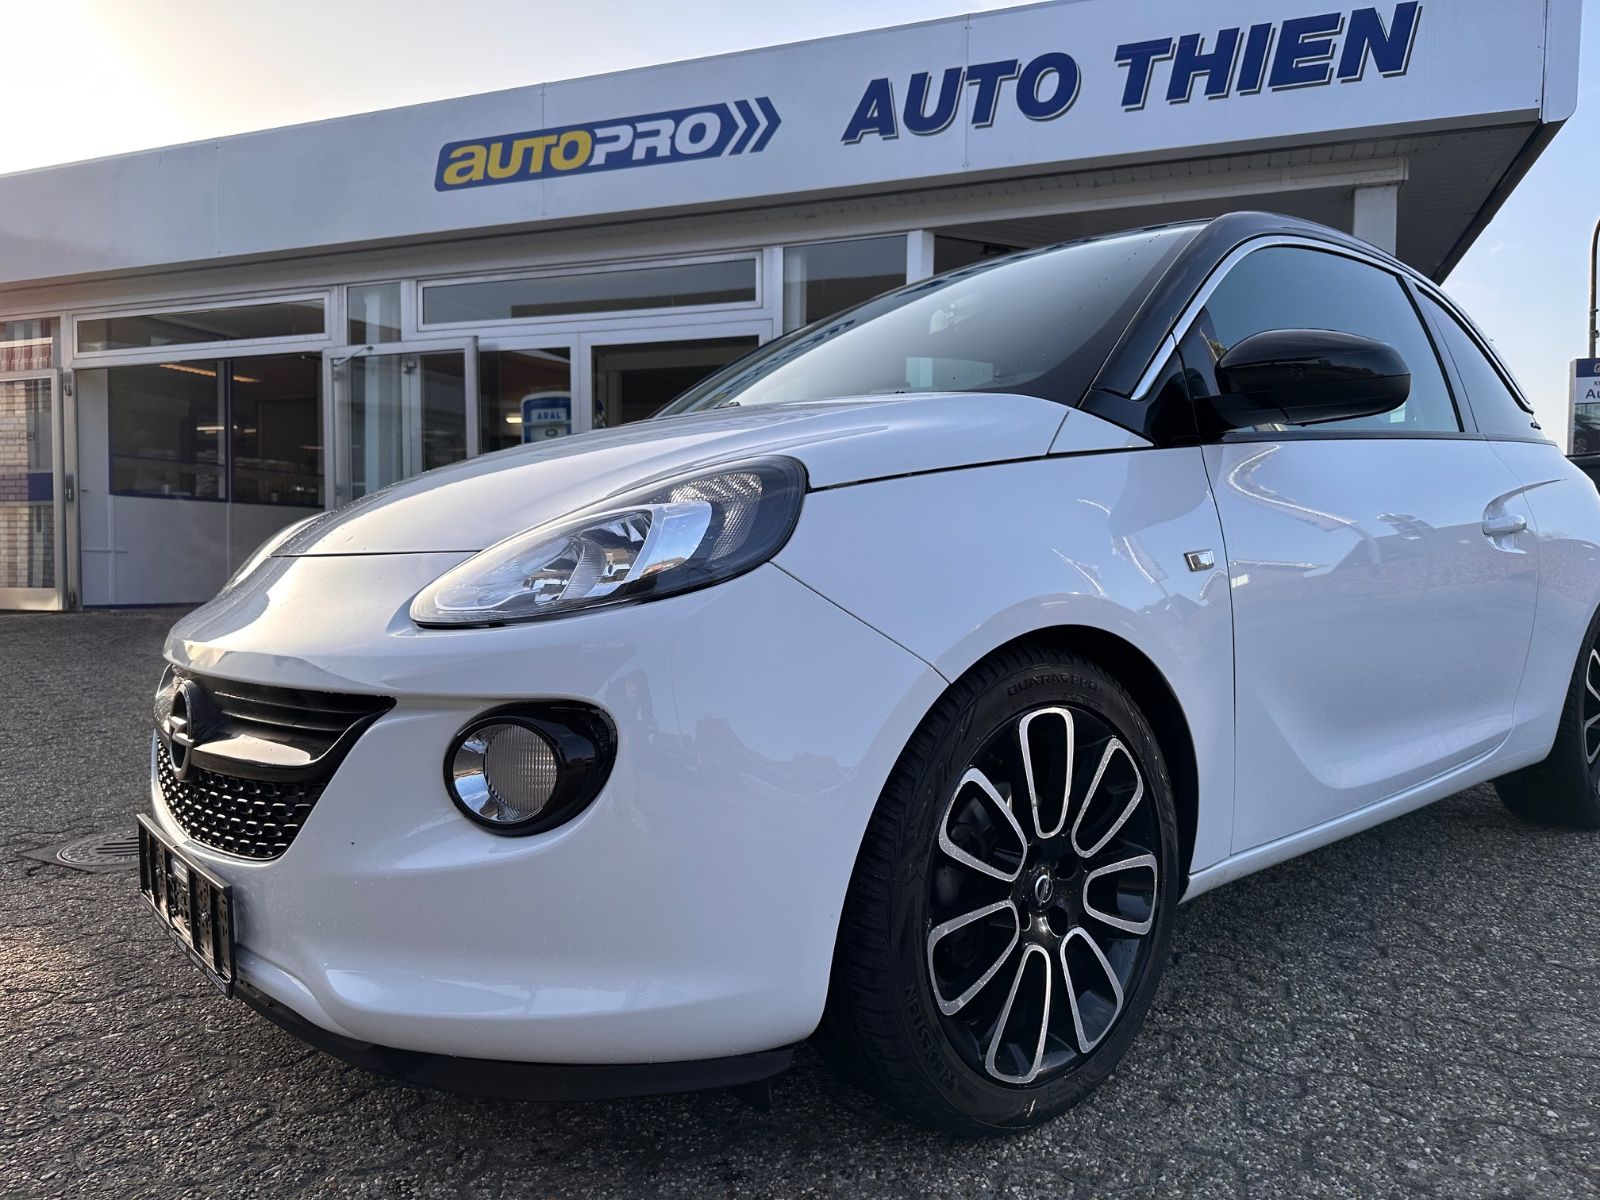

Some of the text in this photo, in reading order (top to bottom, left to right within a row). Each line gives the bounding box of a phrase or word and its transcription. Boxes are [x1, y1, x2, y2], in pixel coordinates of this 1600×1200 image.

[840, 1, 1420, 145] AUTO THIEN
[537, 410, 562, 420] ARAL
